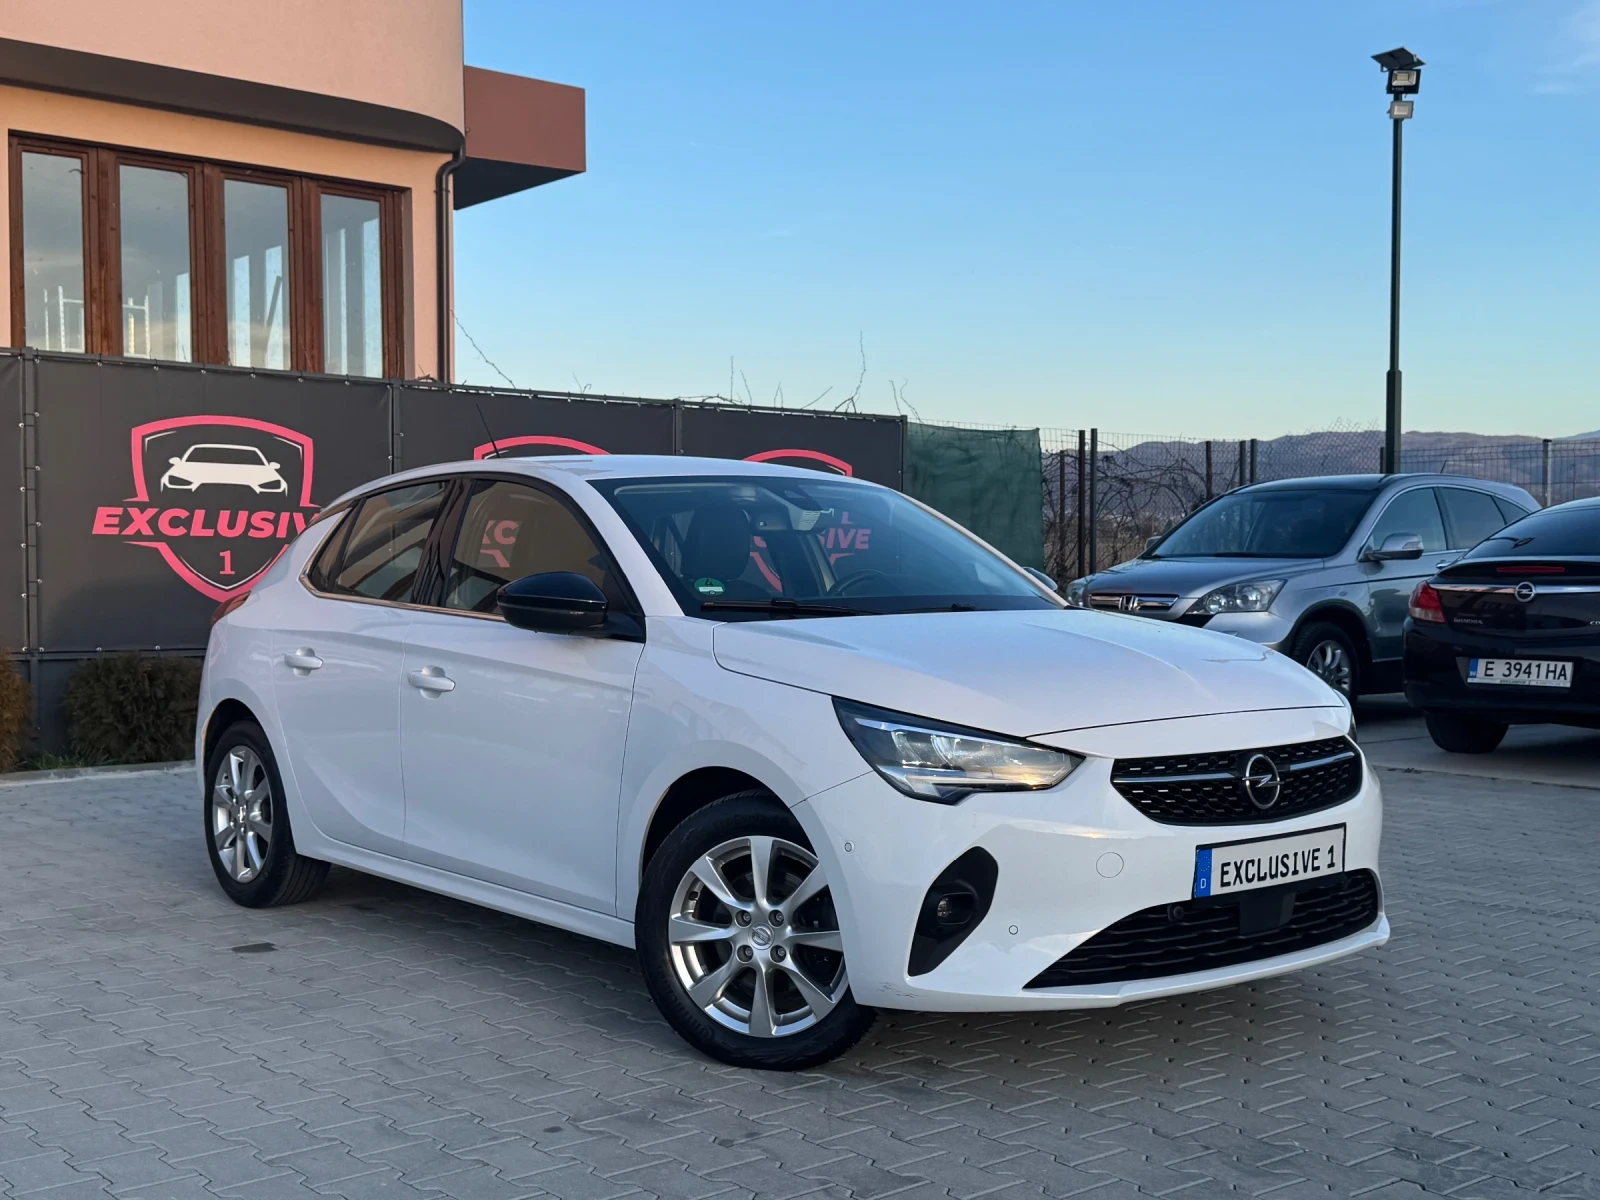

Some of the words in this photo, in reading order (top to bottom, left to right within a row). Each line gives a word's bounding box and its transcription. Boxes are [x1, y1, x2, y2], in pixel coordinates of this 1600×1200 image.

[219, 549, 236, 575] 1
[1484, 661, 1496, 677] E
[1219, 847, 1321, 888] EXCLUSIVE
[1327, 845, 1336, 869] 1
[1200, 878, 1207, 889] D
